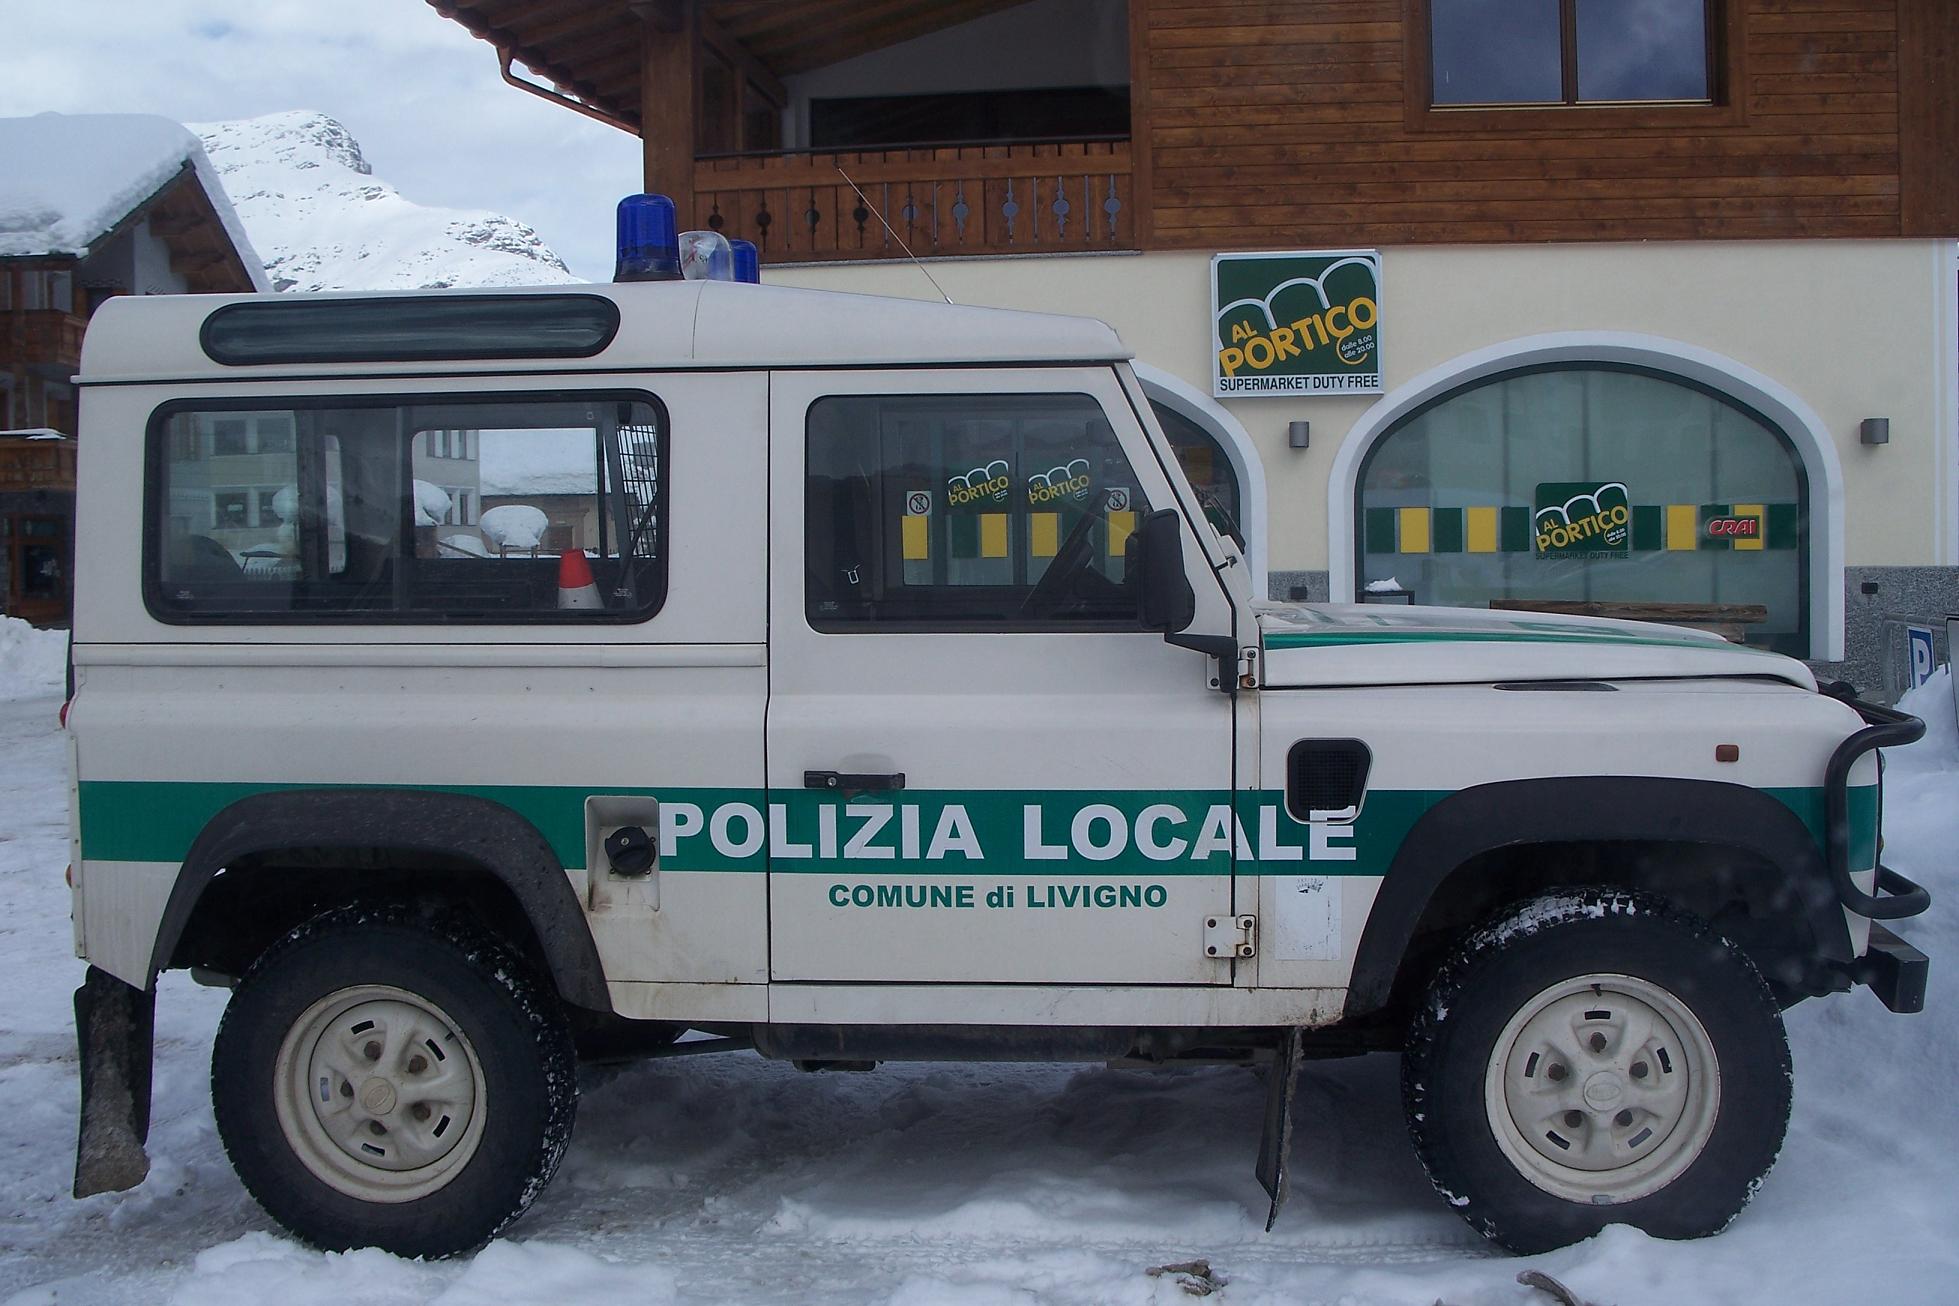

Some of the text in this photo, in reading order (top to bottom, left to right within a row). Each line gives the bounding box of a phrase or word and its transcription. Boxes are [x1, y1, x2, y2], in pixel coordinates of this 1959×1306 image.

[1219, 297, 1377, 377] PORTICO
[1232, 320, 1257, 343] AL
[1220, 375, 1378, 391] SUPERMARKET DUTY FREE
[949, 476, 1009, 506] PORTICO
[1028, 475, 1089, 505] PORTICO
[1536, 505, 1628, 552] PORTICO
[1543, 519, 1558, 532] AL
[1709, 520, 1757, 535] CRAI
[1912, 637, 1930, 689] P
[659, 802, 1357, 861] POLIZIA LOCALE
[829, 884, 1168, 908] COMUNE di LIVIGNO
